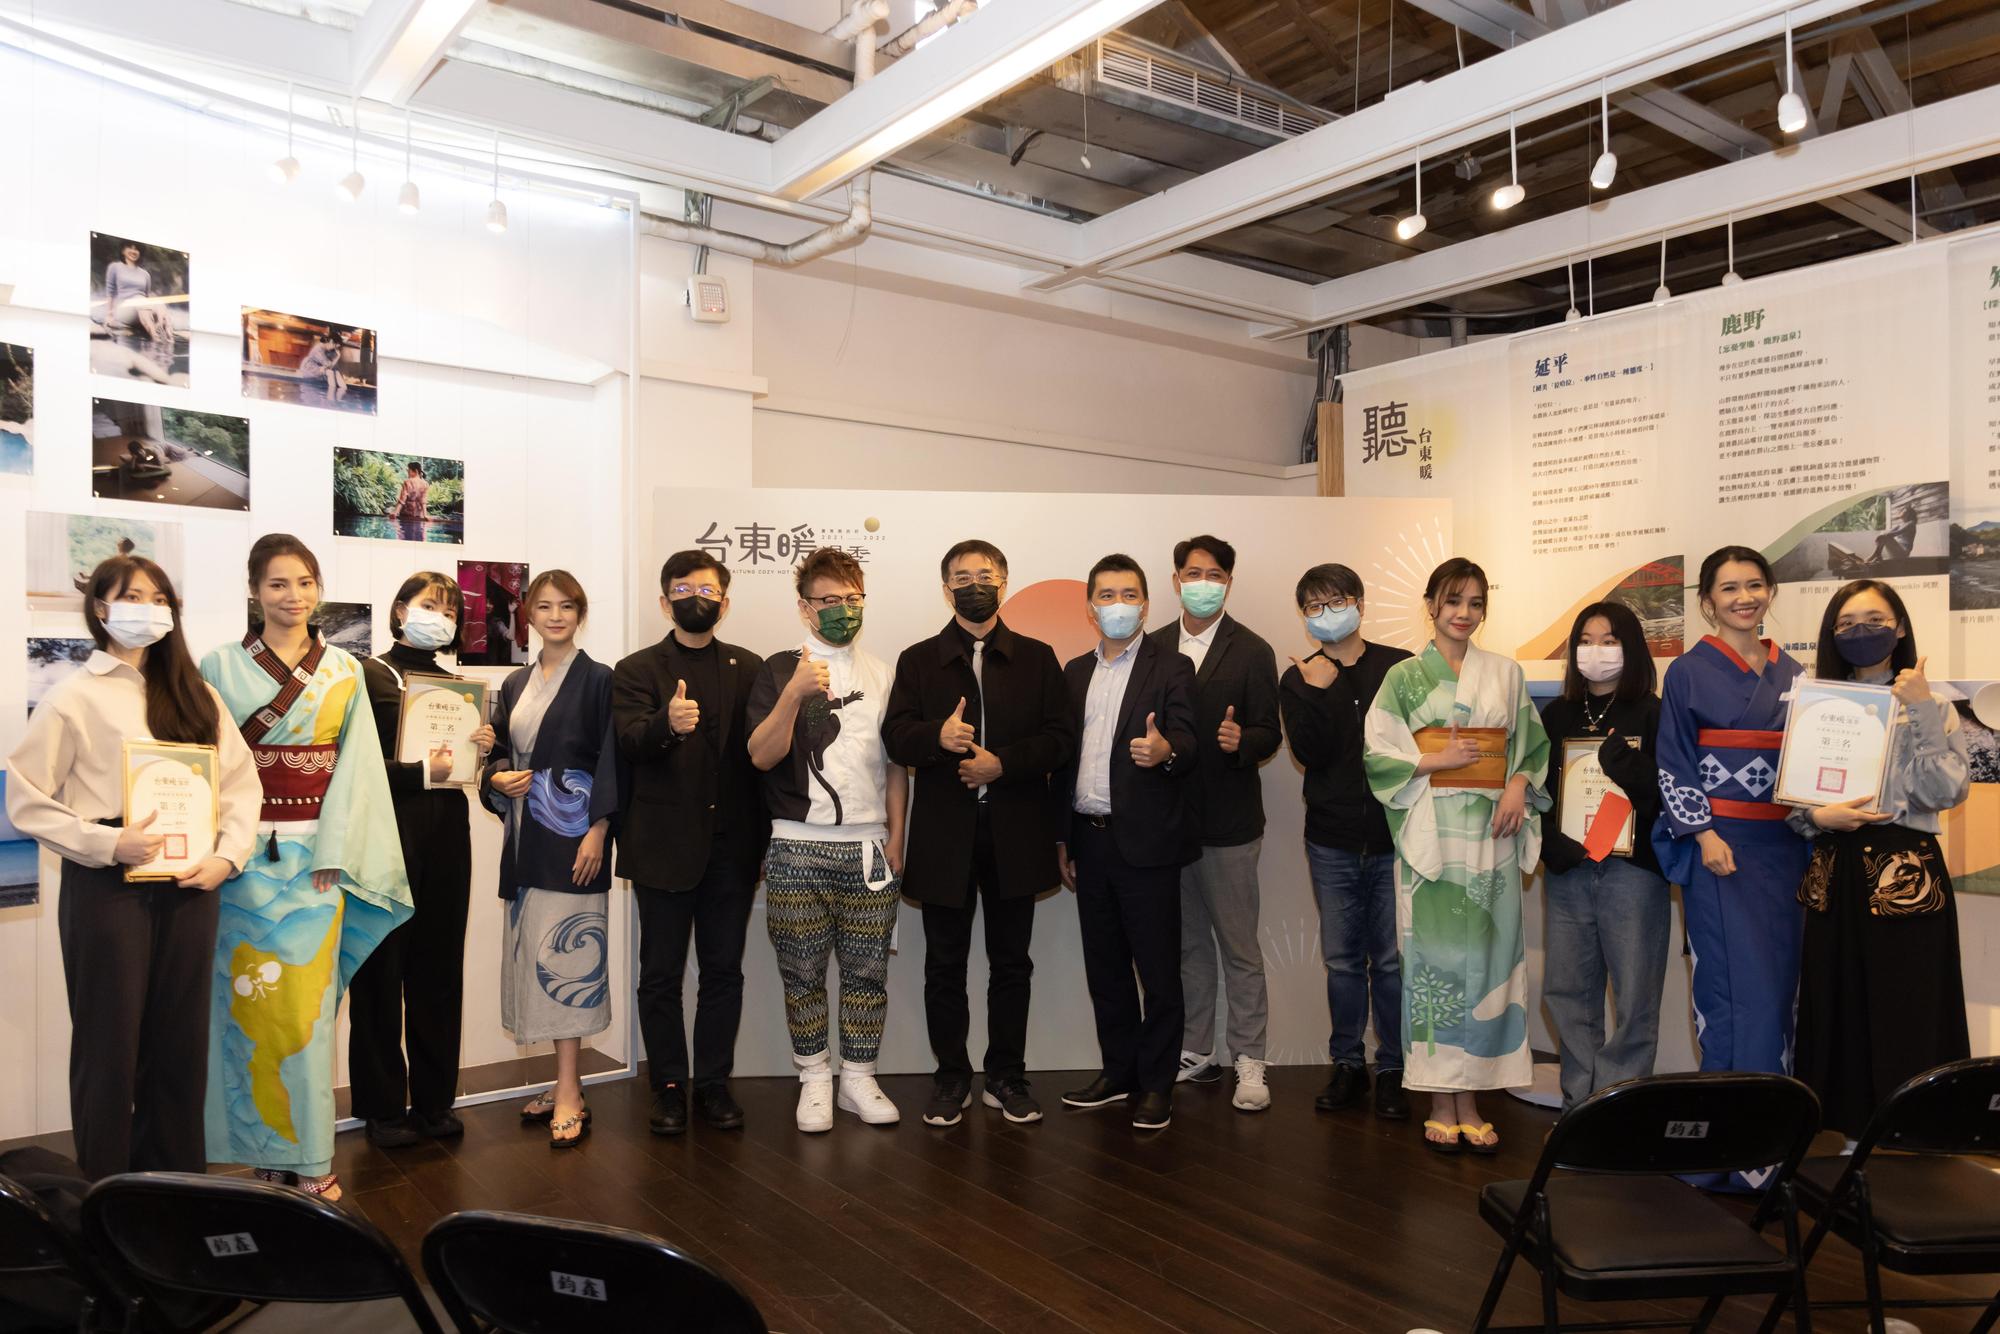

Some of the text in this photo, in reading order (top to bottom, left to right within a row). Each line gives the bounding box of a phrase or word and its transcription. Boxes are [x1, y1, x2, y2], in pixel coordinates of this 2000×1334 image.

[1721, 309, 1765, 336] 鹿野
[1535, 353, 1568, 378] 延平
[1362, 401, 1417, 464] 聽
[1419, 427, 1433, 480] 台東暖
